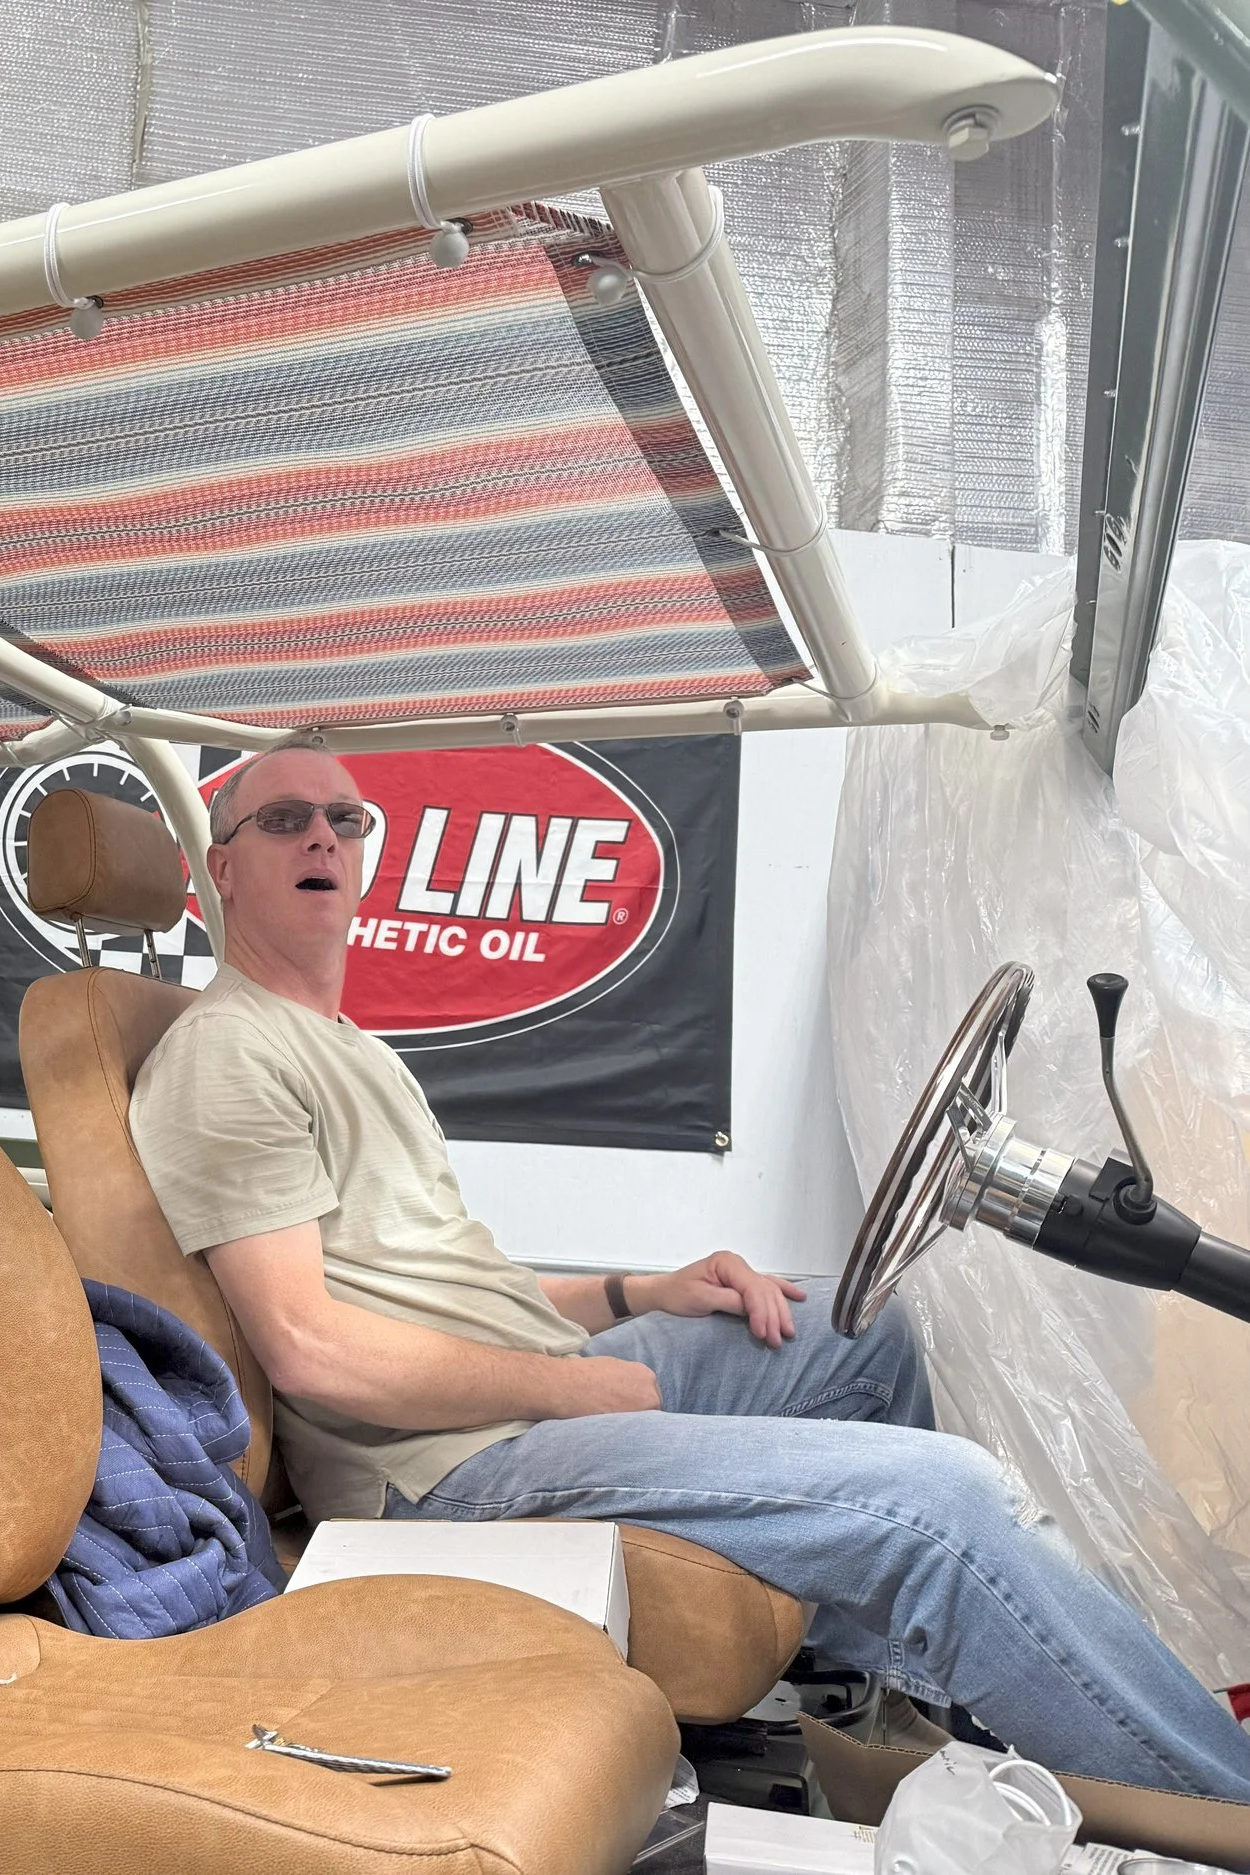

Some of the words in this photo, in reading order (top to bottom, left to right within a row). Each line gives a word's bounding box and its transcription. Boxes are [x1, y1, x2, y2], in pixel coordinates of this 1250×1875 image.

[396, 804, 633, 926] LINE
[346, 917, 469, 957] HETIC
[479, 929, 547, 963] OIL
